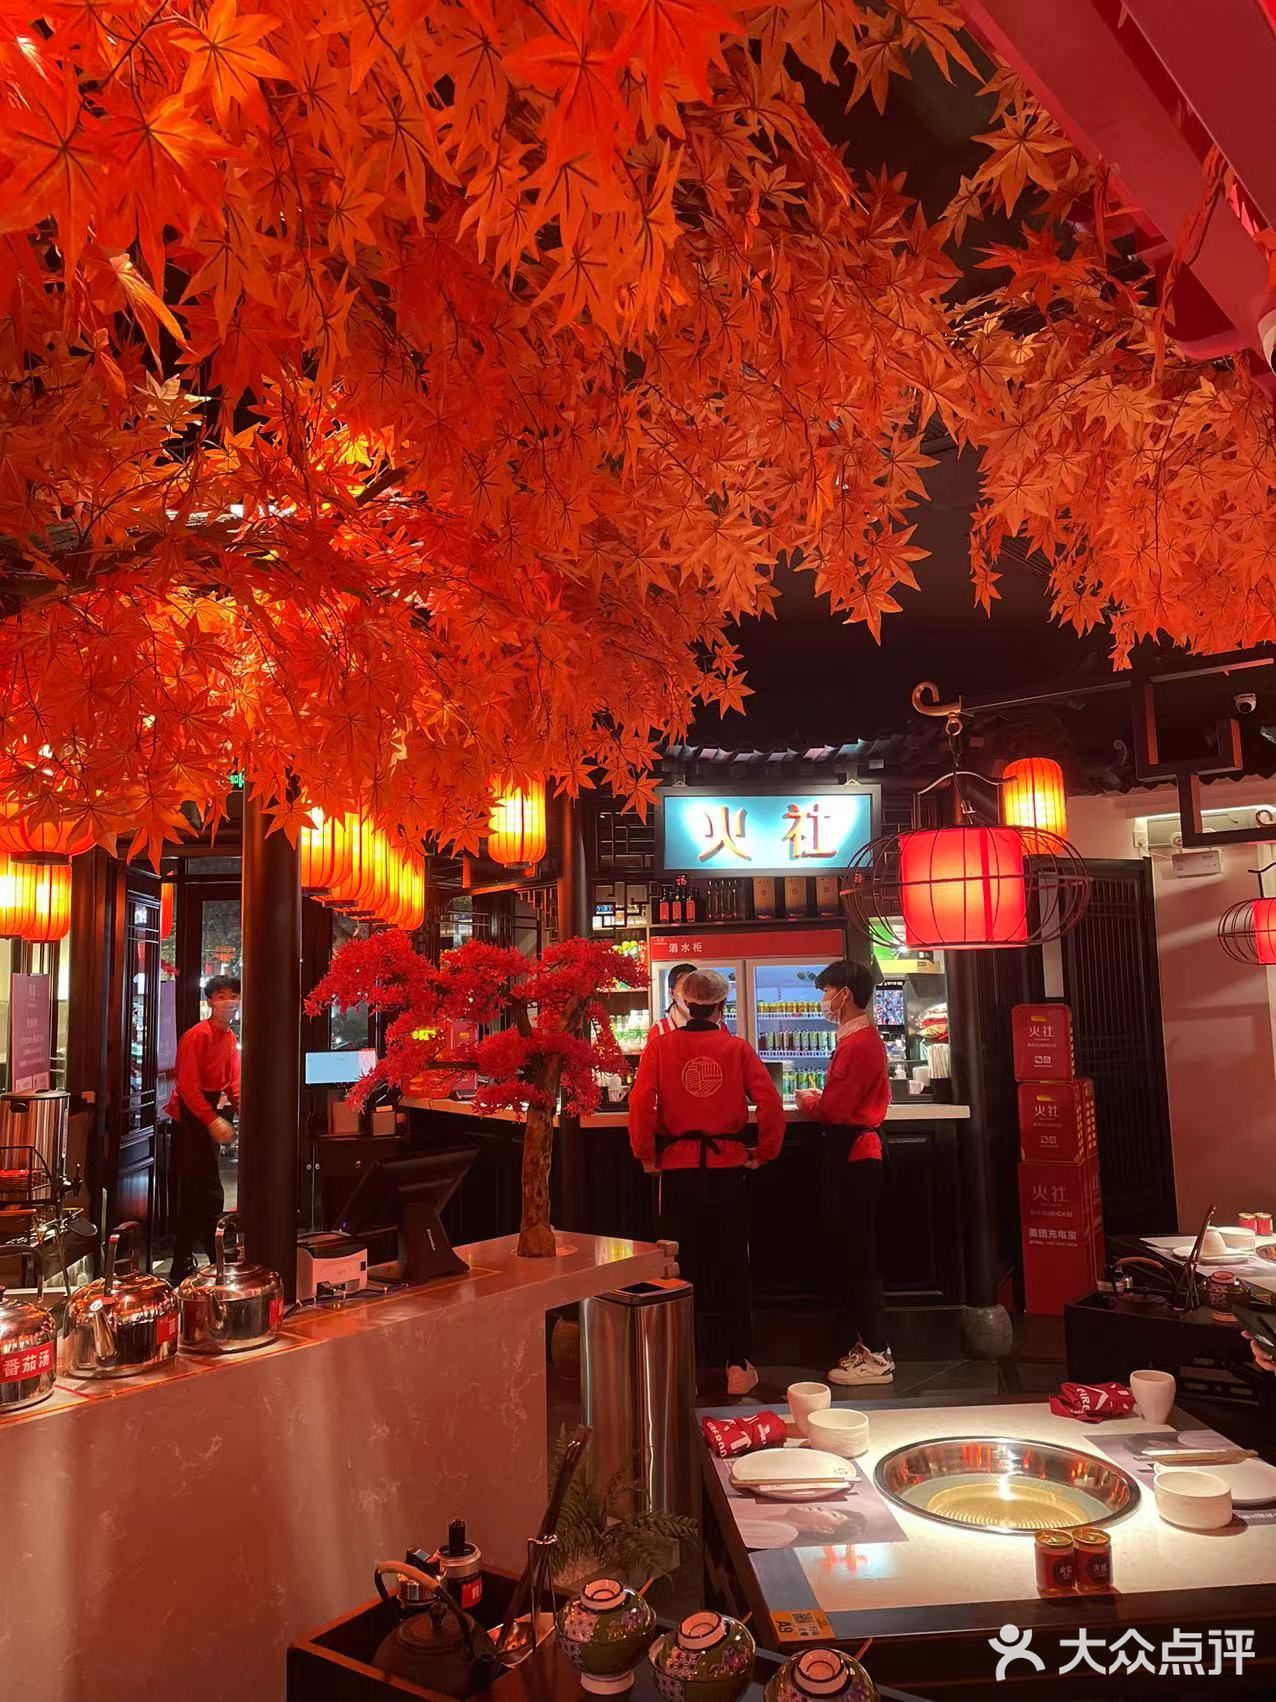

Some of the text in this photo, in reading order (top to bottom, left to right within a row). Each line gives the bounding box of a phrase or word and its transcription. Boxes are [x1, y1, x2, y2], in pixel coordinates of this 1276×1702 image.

[698, 803, 837, 863] 火社
[668, 942, 703, 953] 酒水柜
[1032, 1185, 1069, 1202] 火社
[1028, 1228, 1077, 1240] 美团充电宝
[2, 1349, 50, 1378] 番茄汤
